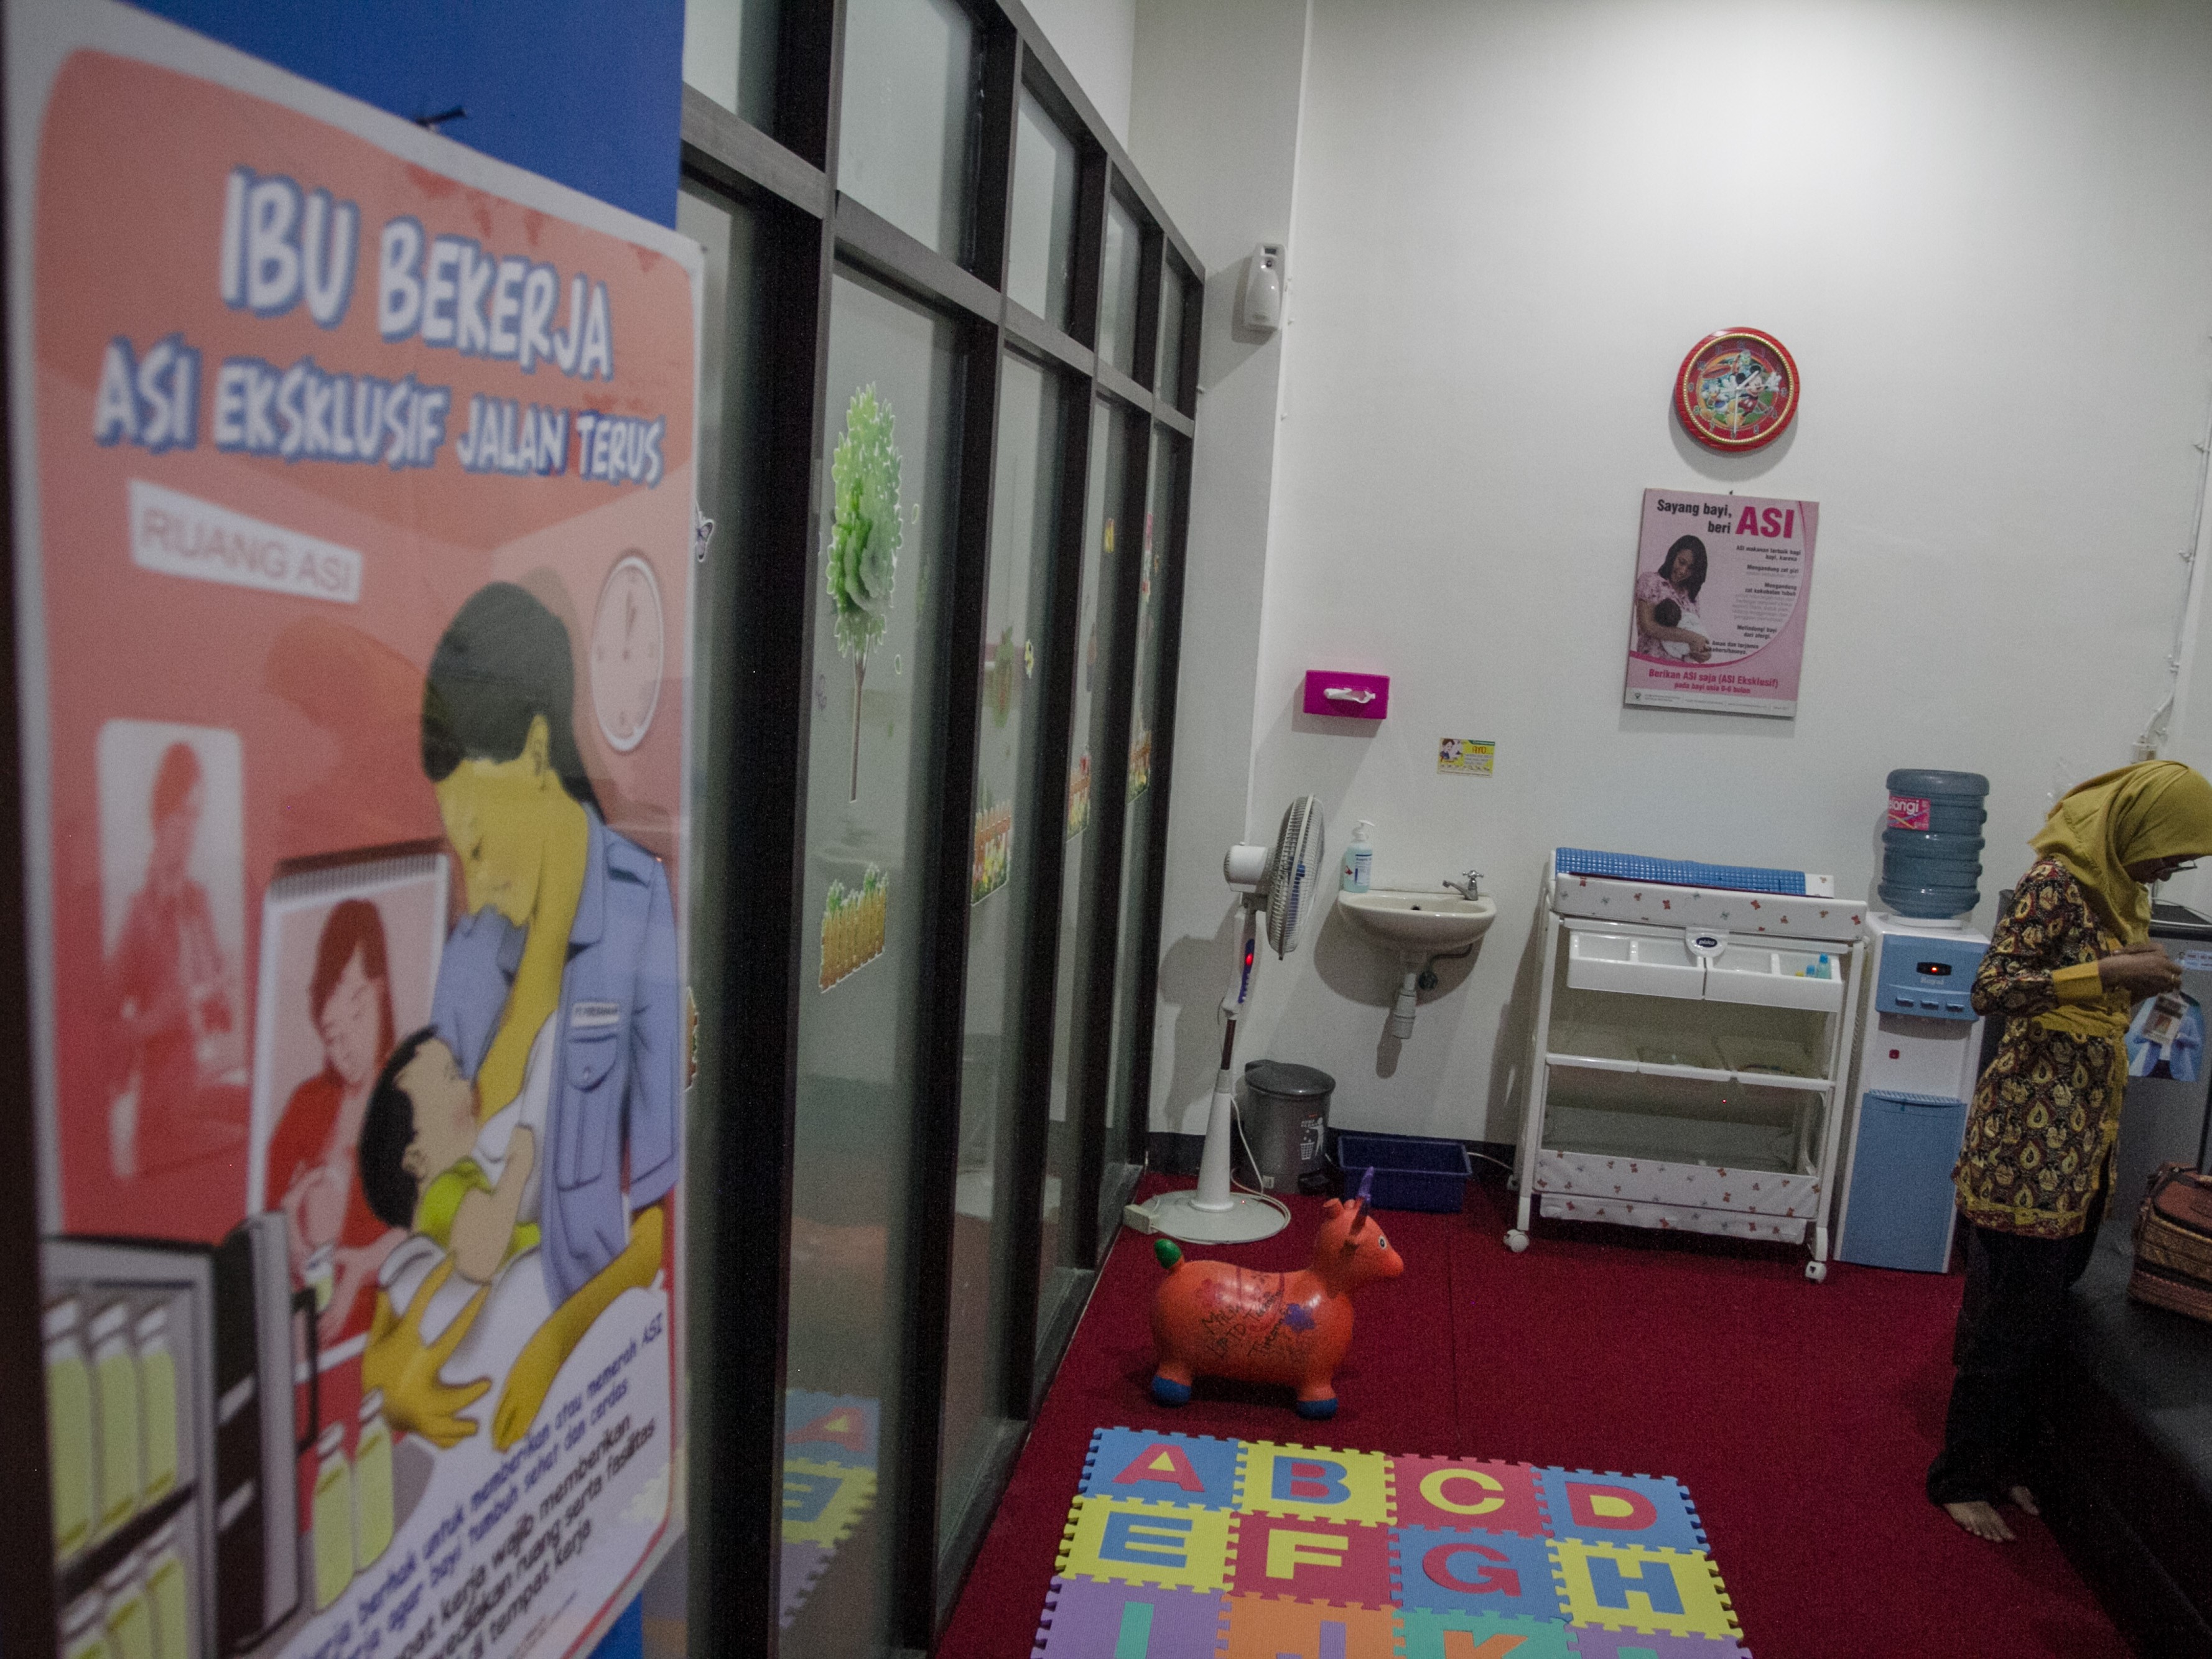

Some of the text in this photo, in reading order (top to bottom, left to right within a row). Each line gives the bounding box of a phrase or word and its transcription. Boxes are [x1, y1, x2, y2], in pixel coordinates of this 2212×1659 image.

[219, 164, 613, 381] IBU BEKERJA
[95, 333, 666, 489] ASI EKSKLUSIF JALAN TERUS
[142, 506, 352, 593] RUANG ASI
[1657, 499, 1732, 518] Sayang bayi,
[1708, 506, 1795, 539] beri ASI
[1648, 669, 1778, 689] Berikan ASI saja (ASI Eksklusif)
[1674, 682, 1689, 690] pada
[1691, 683, 1705, 691] bayi
[1733, 685, 1750, 694] bulan
[1112, 1444, 1657, 1531] A B C D
[440, 1563, 486, 1625] kerja
[491, 1512, 535, 1568] wajib
[489, 1563, 551, 1644] tempat
[553, 1518, 592, 1571] kerja
[1098, 1511, 1685, 1615] E F G H
